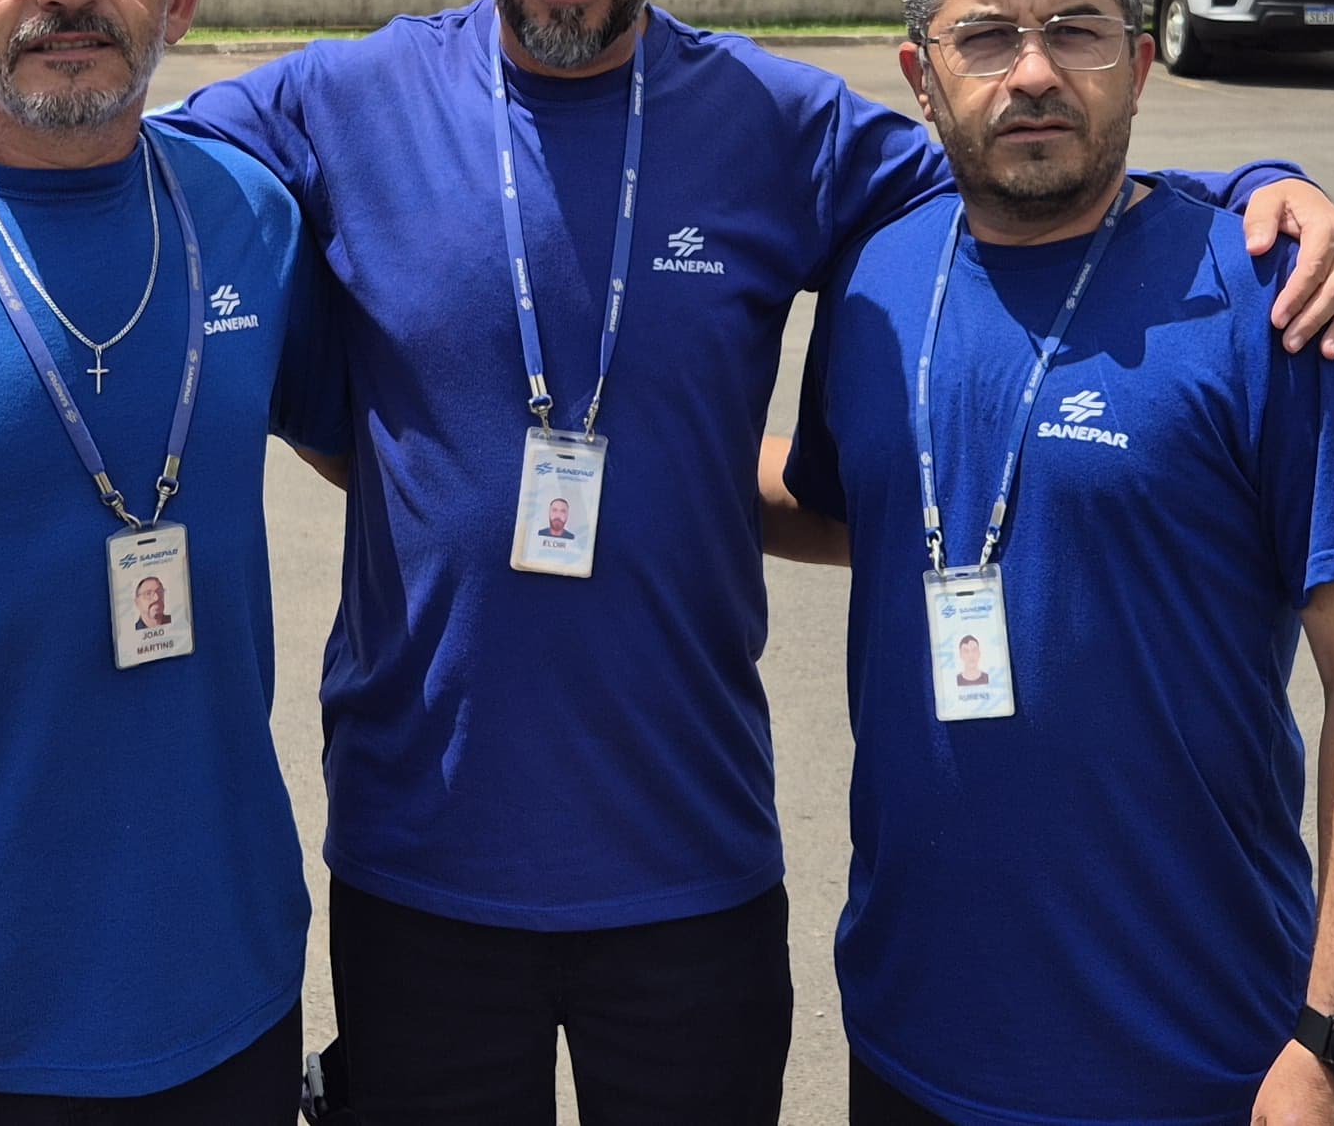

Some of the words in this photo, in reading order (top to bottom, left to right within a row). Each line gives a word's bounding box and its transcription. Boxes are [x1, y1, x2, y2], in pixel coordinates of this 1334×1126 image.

[651, 257, 725, 275] SANEPAR
[203, 314, 259, 336] SANEPAR
[1037, 422, 1129, 450] SANEPAR
[137, 640, 174, 654] MARTINS
